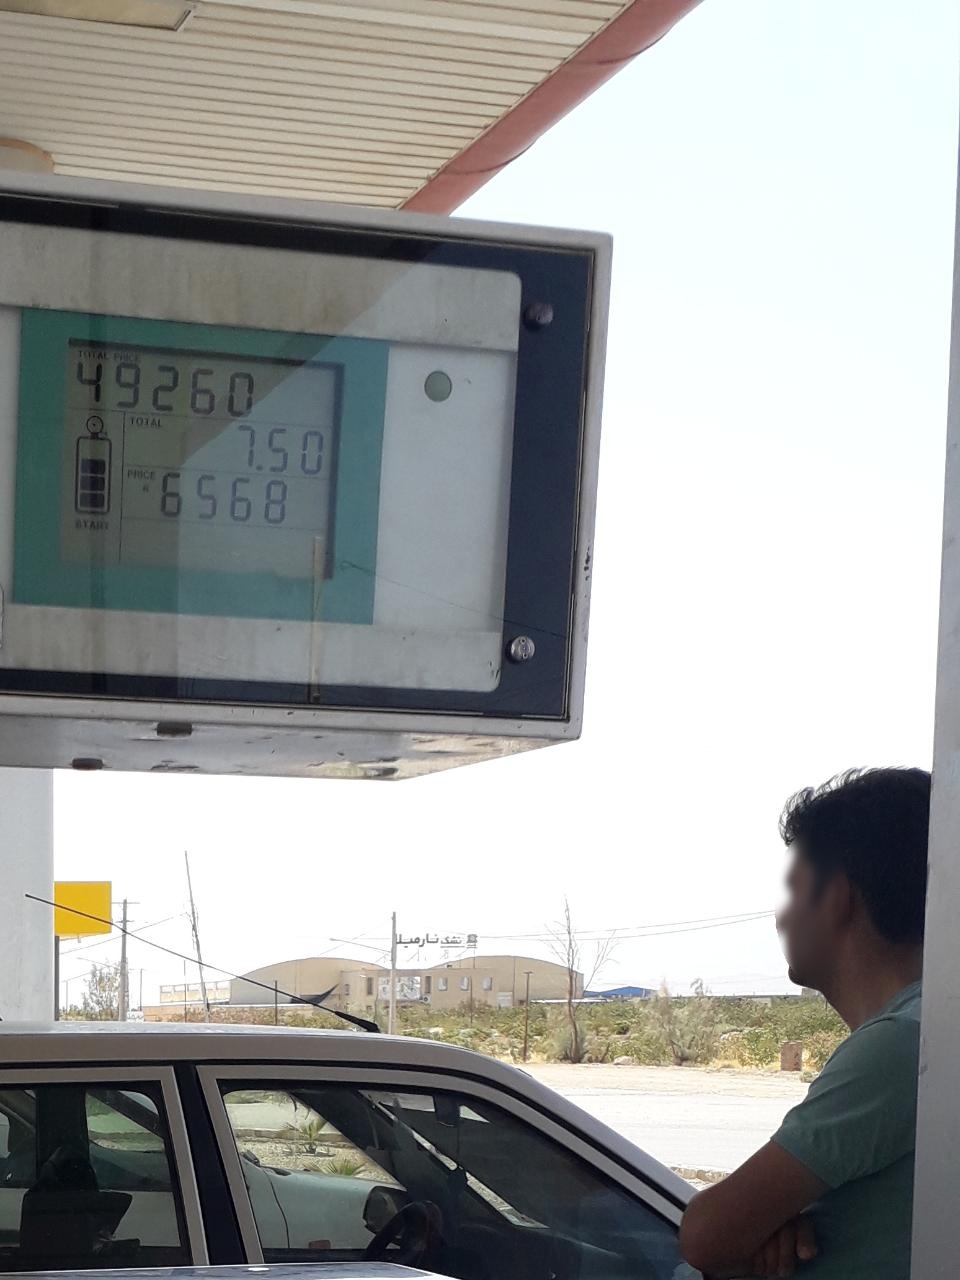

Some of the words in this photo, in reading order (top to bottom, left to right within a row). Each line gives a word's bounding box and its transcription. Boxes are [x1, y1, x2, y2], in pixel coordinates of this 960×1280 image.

[76, 362, 254, 417] 49260
[130, 416, 162, 427] TOTAL
[238, 424, 324, 475] 7.50
[160, 471, 288, 524] 6568
